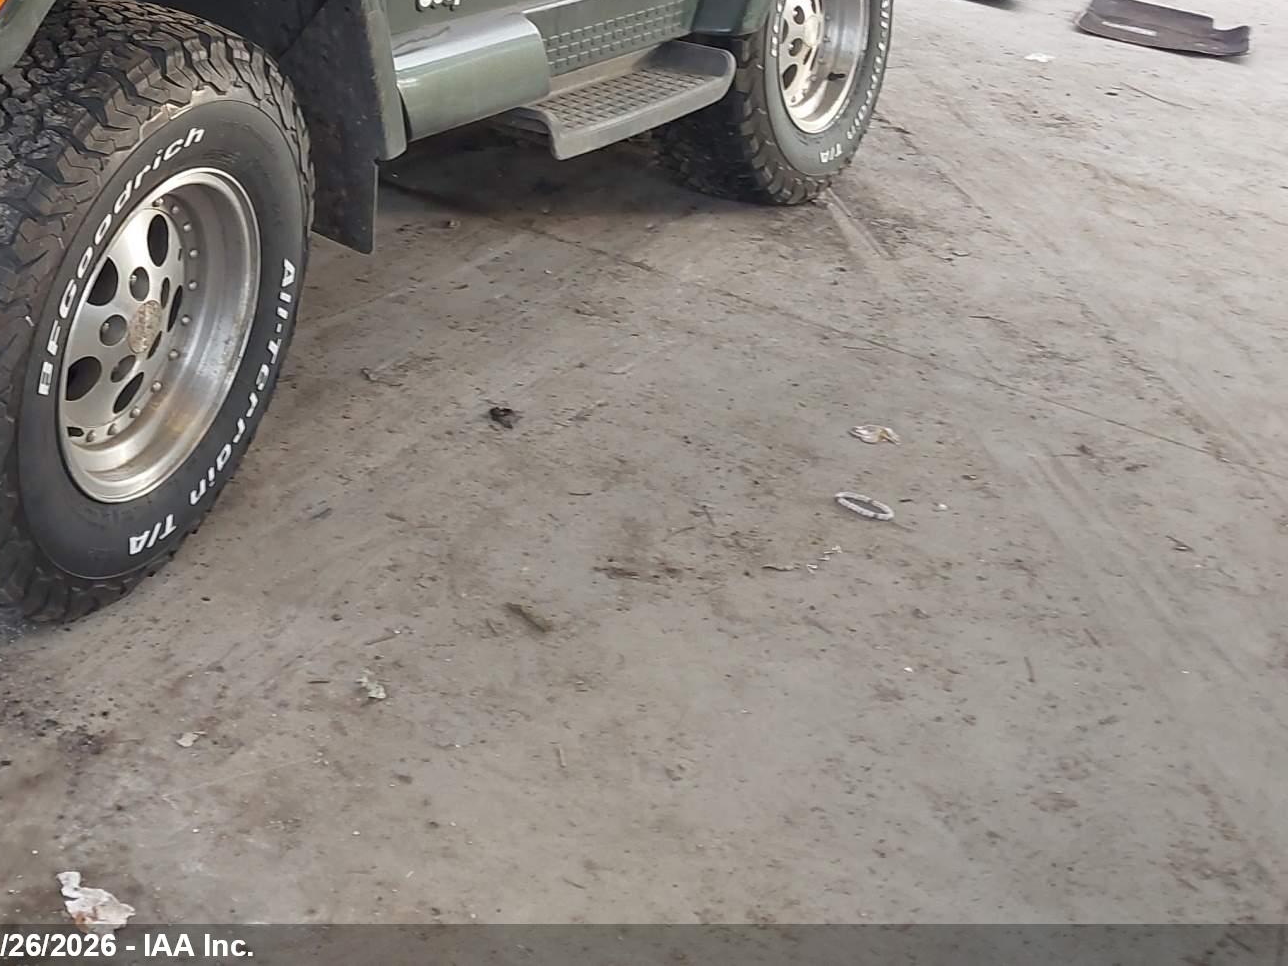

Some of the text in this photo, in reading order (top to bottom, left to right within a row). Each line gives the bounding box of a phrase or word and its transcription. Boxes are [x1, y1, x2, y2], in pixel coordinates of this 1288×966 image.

[37, 126, 206, 396] BFGoodrich
[128, 257, 298, 556] All-Terrain T/A
